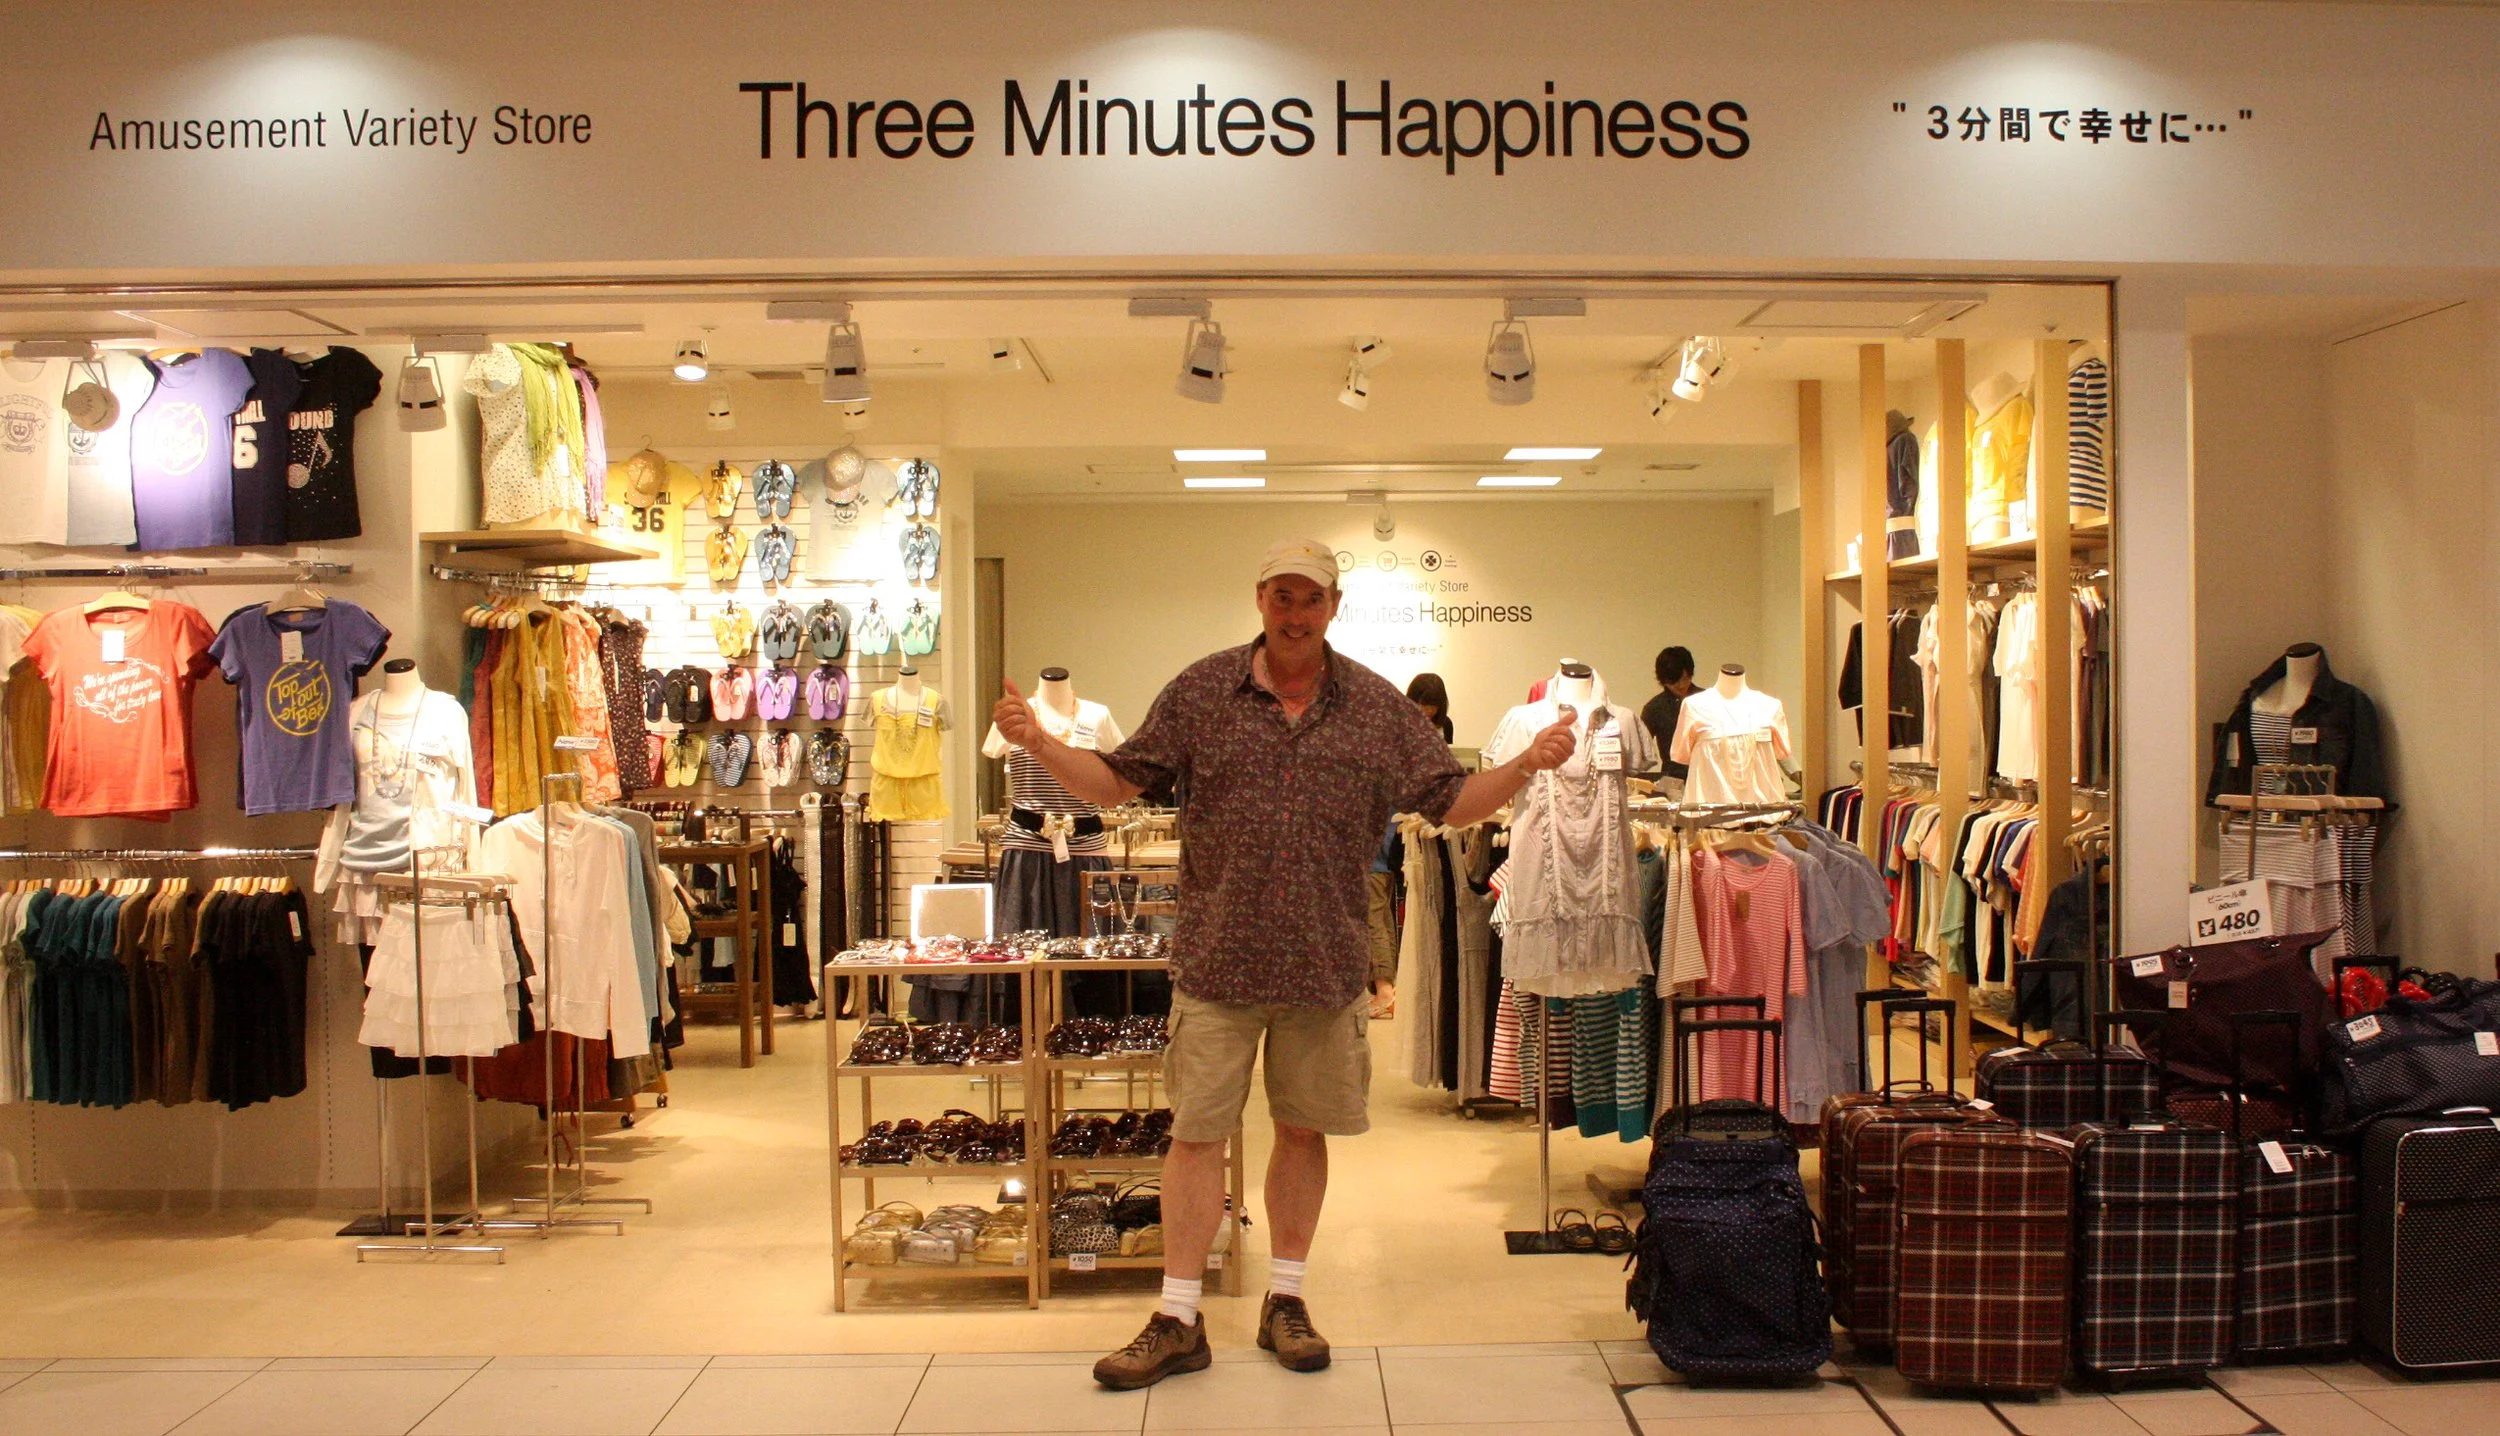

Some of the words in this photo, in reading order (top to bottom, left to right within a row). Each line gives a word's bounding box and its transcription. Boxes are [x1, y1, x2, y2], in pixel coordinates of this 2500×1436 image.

[89, 111, 327, 151] Amusement
[342, 107, 478, 155] Variety
[493, 105, 592, 146] Store
[738, 81, 975, 160] Three
[1004, 79, 1316, 158] Minutes
[1336, 79, 1751, 177] Happiness
[287, 410, 334, 431] OUND
[631, 507, 665, 533] 36
[1400, 581, 1436, 595] ariety
[1439, 580, 1469, 593] Store
[1419, 600, 1533, 628] Happiness
[272, 673, 299, 707] Top
[297, 675, 323, 707] out
